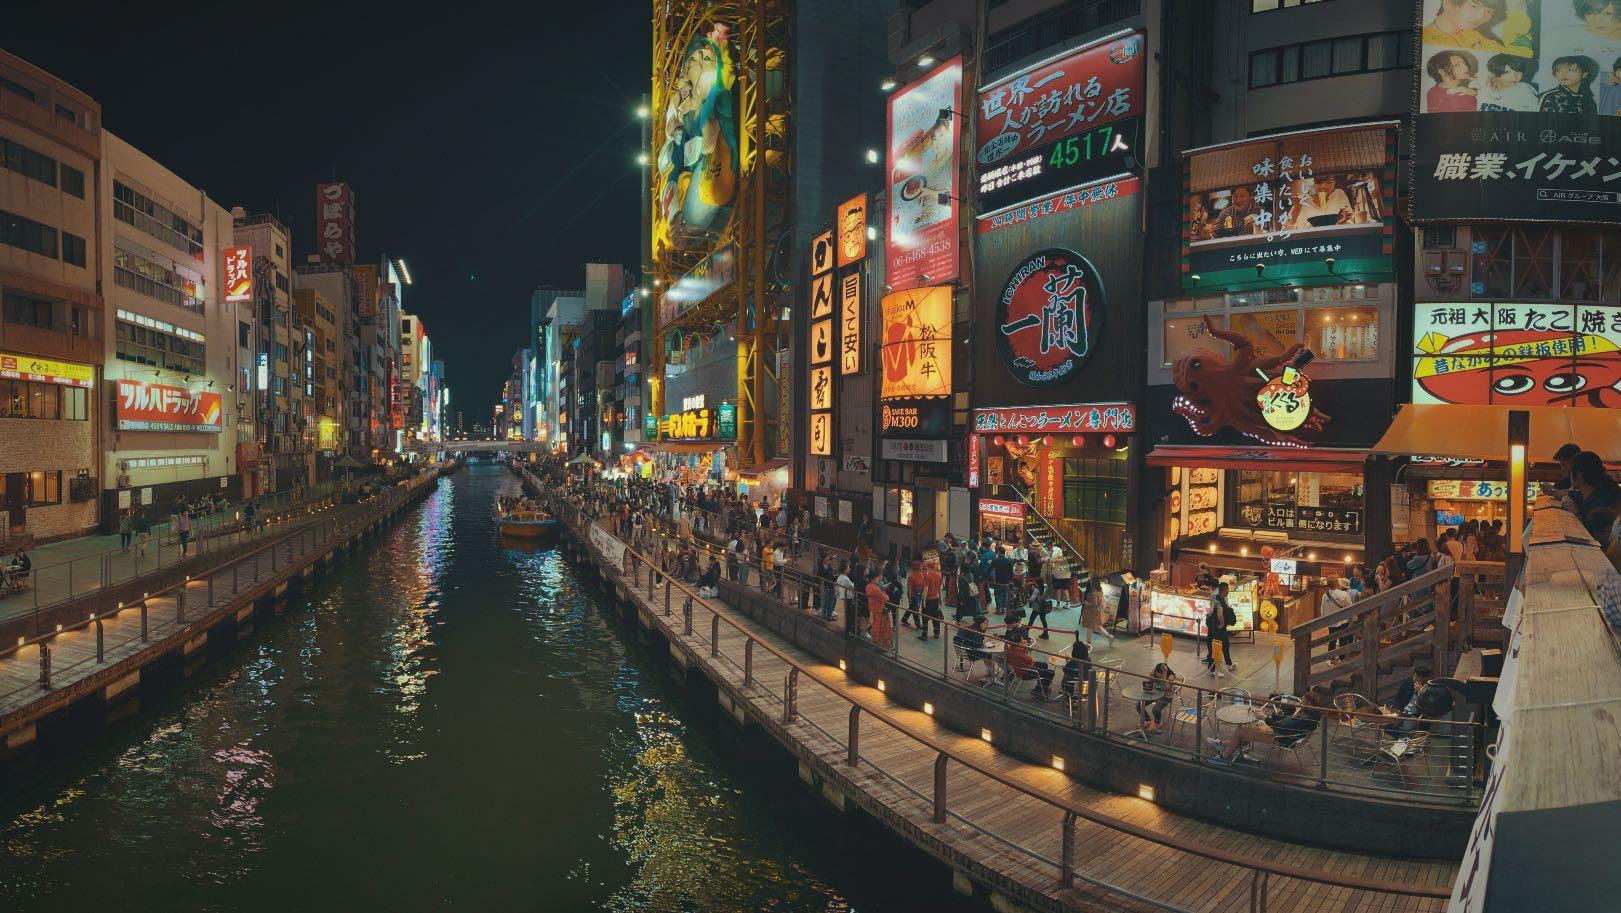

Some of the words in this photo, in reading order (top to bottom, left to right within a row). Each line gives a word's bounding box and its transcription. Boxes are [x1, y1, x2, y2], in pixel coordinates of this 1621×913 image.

[981, 70, 1065, 121] 世界一
[1000, 76, 1101, 134] 人が訪れる
[1027, 88, 1131, 145] ラーメン店
[1490, 131, 1528, 142] AIR
[1278, 155, 1294, 241] 食べたいから
[1002, 255, 1046, 304] ICHIRAN
[843, 276, 858, 371] 旨くて安い
[1001, 264, 1088, 357] 一蘭
[920, 323, 937, 380] 松阪牛
[120, 383, 202, 415] ツルハドラッグ
[891, 415, 918, 428] M300
[904, 407, 918, 415] BAR
[1267, 508, 1295, 518] 入口は
